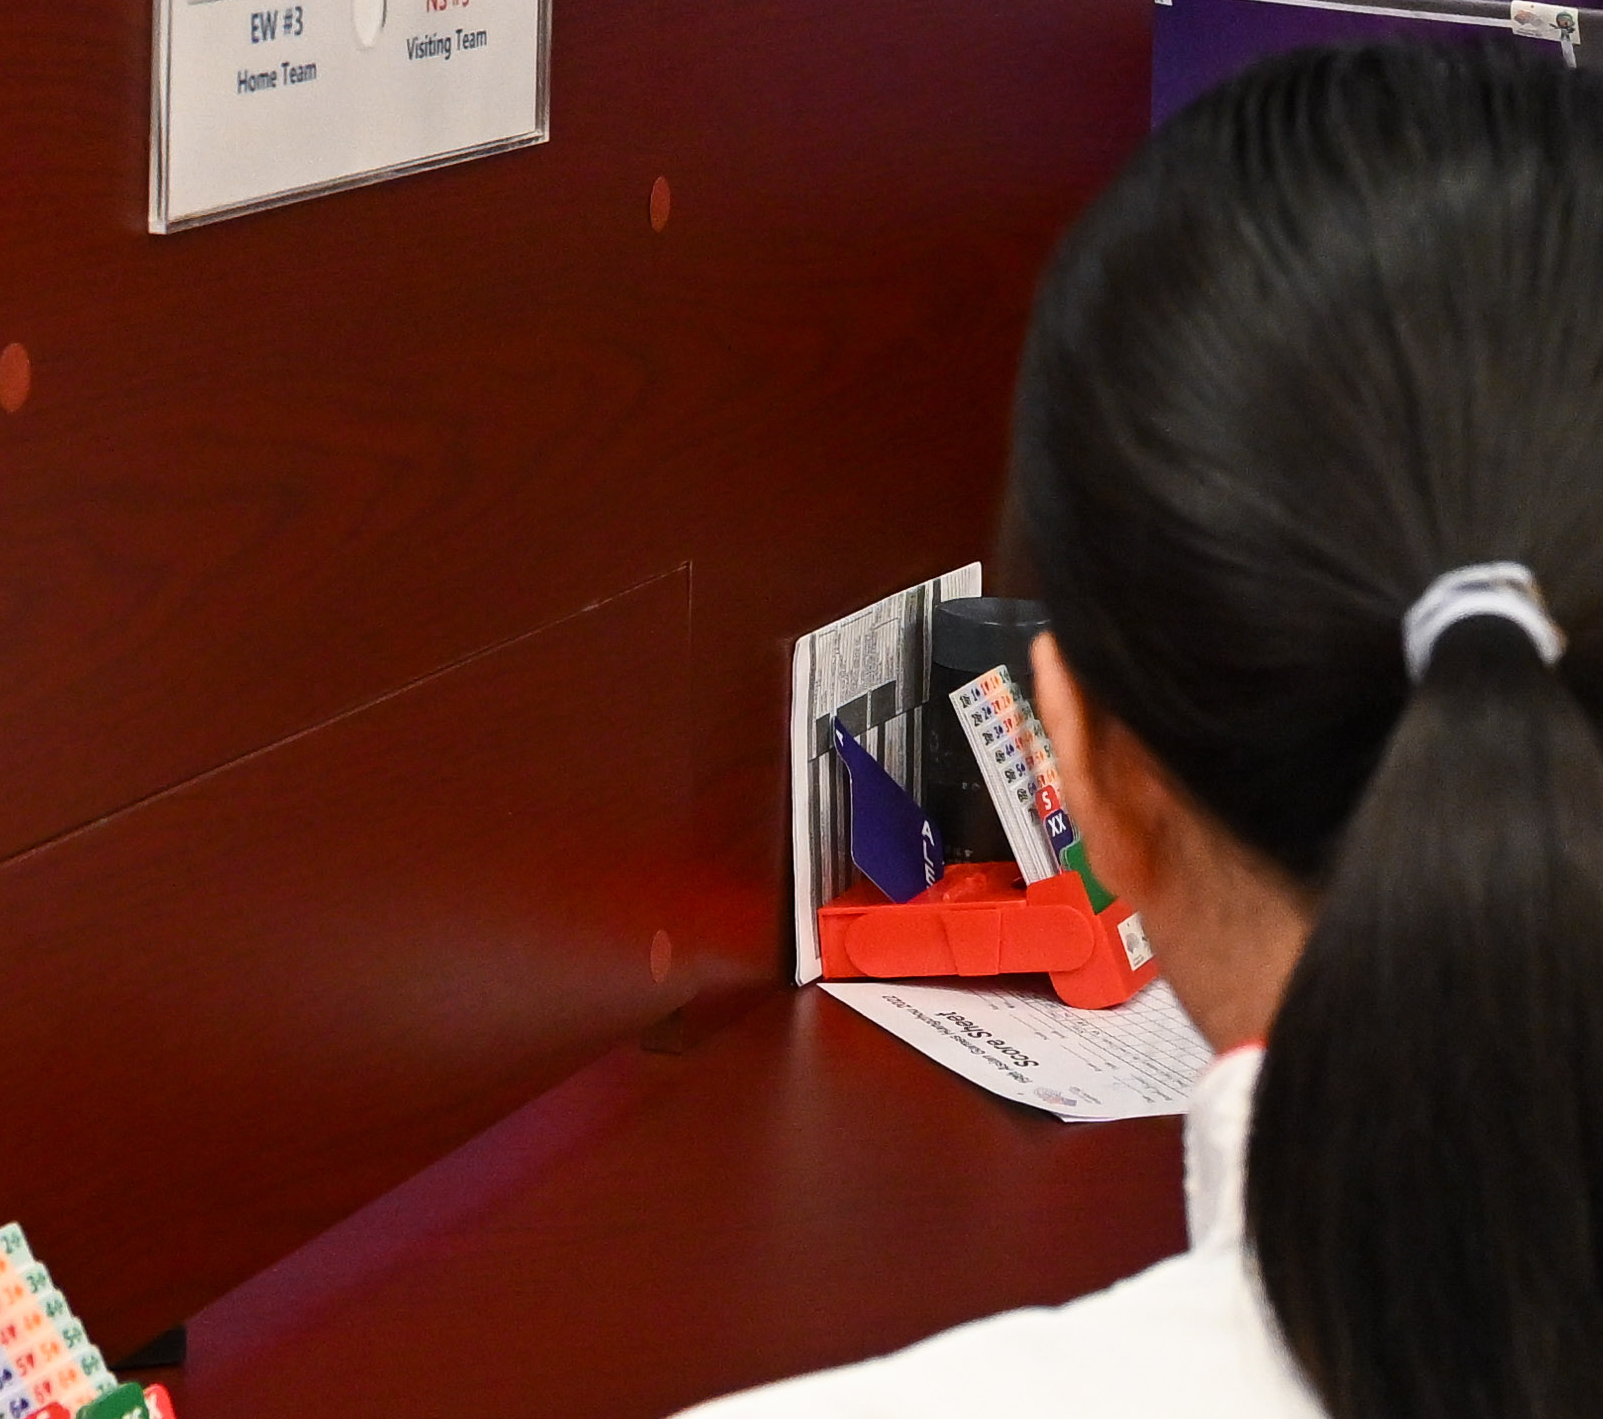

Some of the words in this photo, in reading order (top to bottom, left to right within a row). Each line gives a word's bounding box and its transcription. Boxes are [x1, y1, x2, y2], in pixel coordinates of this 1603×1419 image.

[250, 9, 279, 45] EW
[283, 5, 305, 37] #3
[406, 32, 452, 61] Visiting
[455, 28, 488, 52] Team
[236, 69, 278, 95] Home
[281, 61, 318, 86] Team
[1042, 791, 1052, 810] S
[1048, 813, 1066, 837] XX
[921, 819, 936, 889] ALE
[935, 1011, 993, 1040] Sheet
[986, 1038, 1041, 1069] Score
